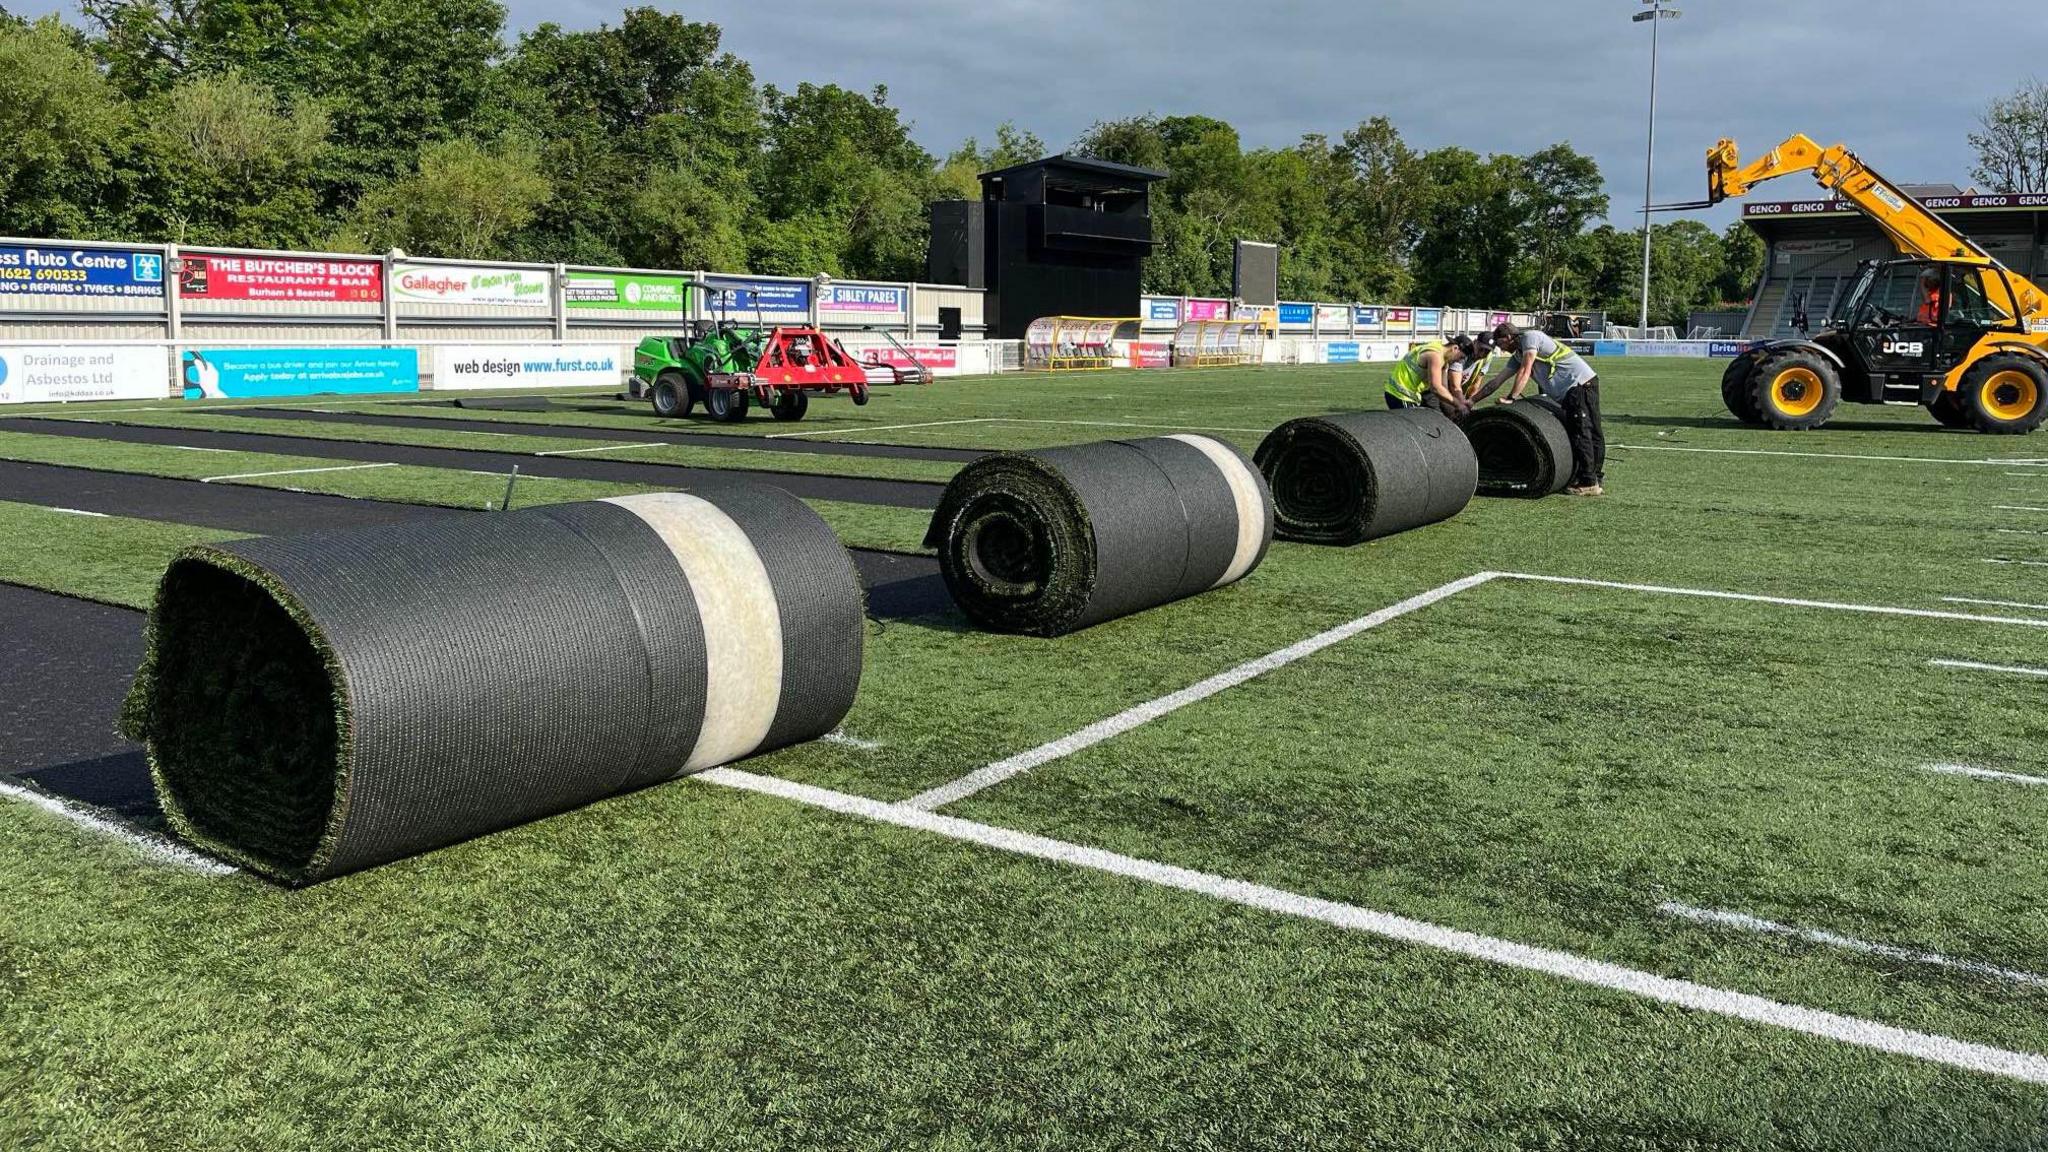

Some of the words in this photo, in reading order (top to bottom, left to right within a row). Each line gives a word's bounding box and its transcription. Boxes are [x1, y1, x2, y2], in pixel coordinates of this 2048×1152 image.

[1925, 198, 1961, 207] GENCO
[1971, 196, 2007, 206] GENCO
[2019, 196, 2048, 205] GENC
[1749, 204, 1781, 214] GENCO
[1791, 202, 1824, 212] GENCO
[26, 250, 67, 267] Auto
[72, 251, 128, 269] Centre
[210, 259, 240, 272] THE
[245, 260, 327, 275] BUTCHER'S
[330, 263, 375, 277] BLOCK
[36, 269, 87, 281] 690333
[227, 274, 325, 286] RESTAURANT
[327, 277, 339, 286] &
[341, 278, 370, 287] BAR
[29, 283, 73, 293] REPAIRS
[83, 284, 115, 294] TYRES
[123, 285, 163, 295] BRAKES
[402, 274, 468, 294] Gallagher
[249, 288, 285, 298] Burham
[287, 289, 294, 297] &
[296, 289, 336, 298] Bearsted
[836, 289, 867, 302] SIBLEY
[868, 290, 895, 304] PARES
[1883, 342, 1923, 353] JCB
[24, 354, 86, 367] Drainage
[89, 353, 114, 365] and
[223, 362, 258, 370] Become
[283, 361, 306, 369] driver
[454, 359, 479, 374] web
[482, 358, 521, 376] design
[523, 358, 614, 373] www.furst.co.uk
[26, 373, 89, 386] Asbestos
[92, 372, 113, 384] Ltd
[243, 373, 268, 382] Apply
[271, 372, 295, 381] today
